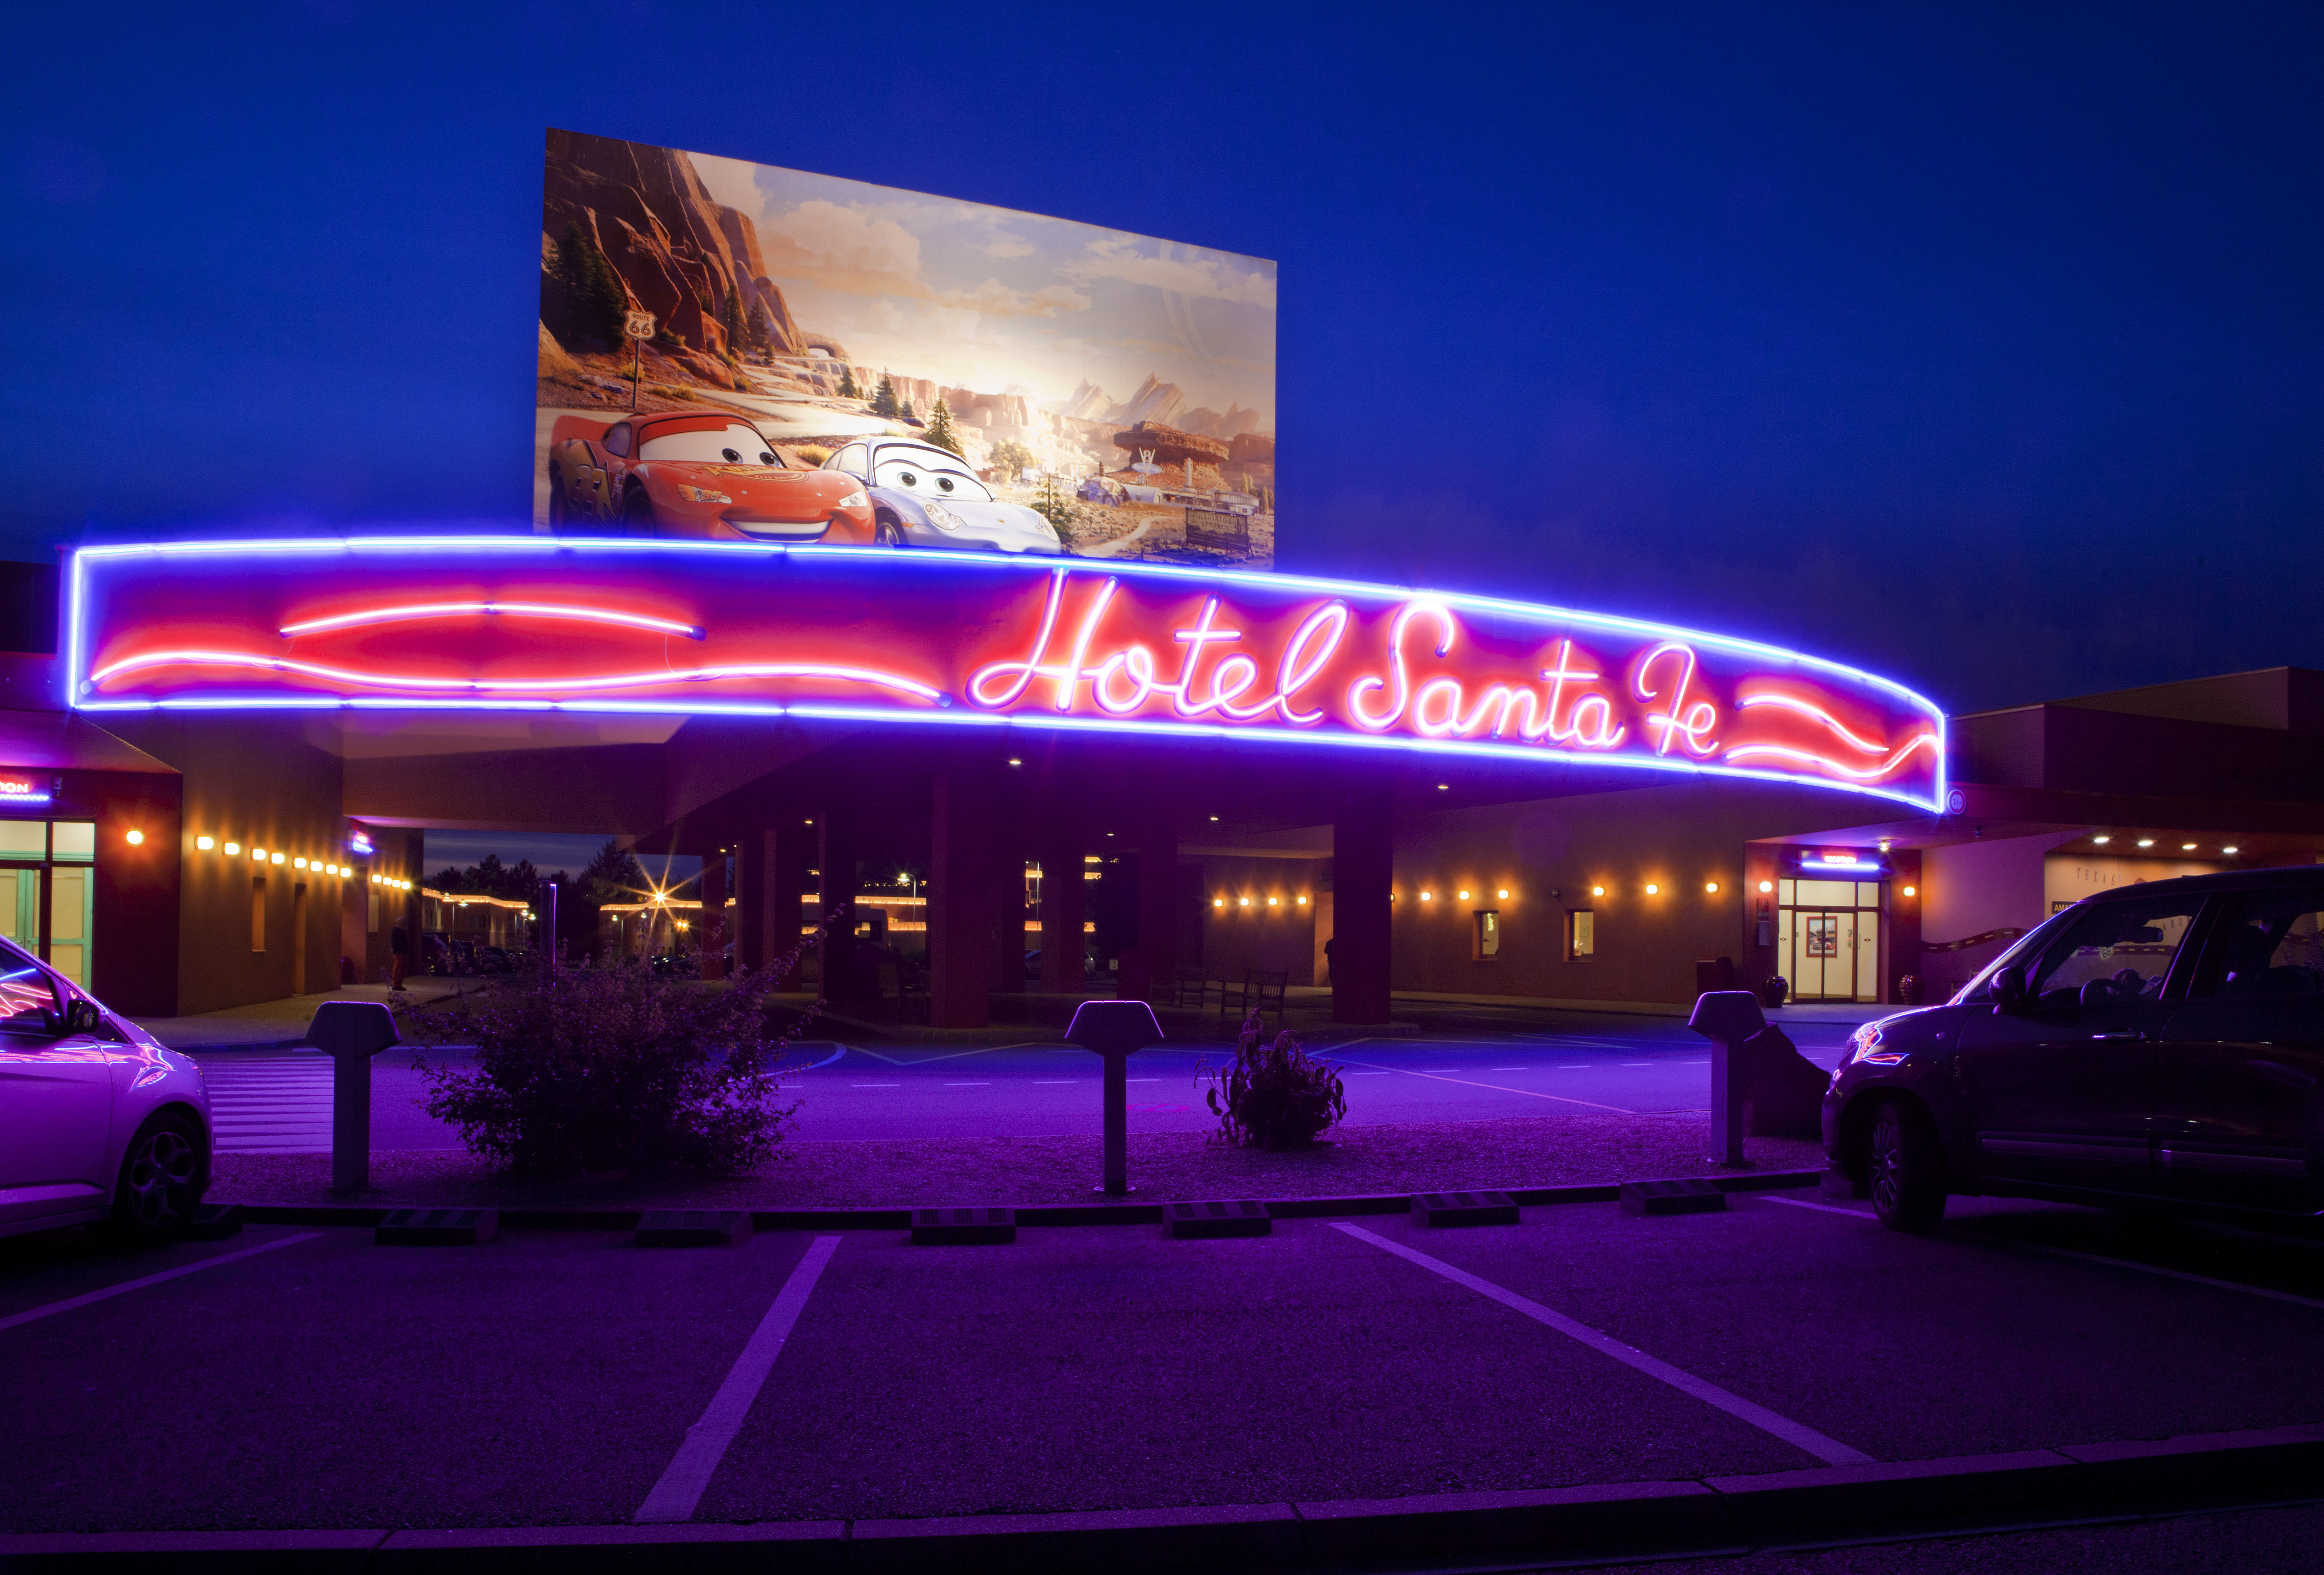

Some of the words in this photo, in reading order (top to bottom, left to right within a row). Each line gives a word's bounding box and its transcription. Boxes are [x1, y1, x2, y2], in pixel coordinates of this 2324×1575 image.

[629, 320, 651, 335] 66
[570, 464, 604, 528] 95
[701, 489, 722, 500] 95
[1198, 514, 1232, 525] RADIATOR
[1201, 521, 1229, 531] SPRINGS
[966, 565, 1350, 725] Hotel
[1347, 600, 1625, 750] Santa
[1632, 641, 1719, 757] Fe
[2077, 868, 2115, 886] TEXAS
